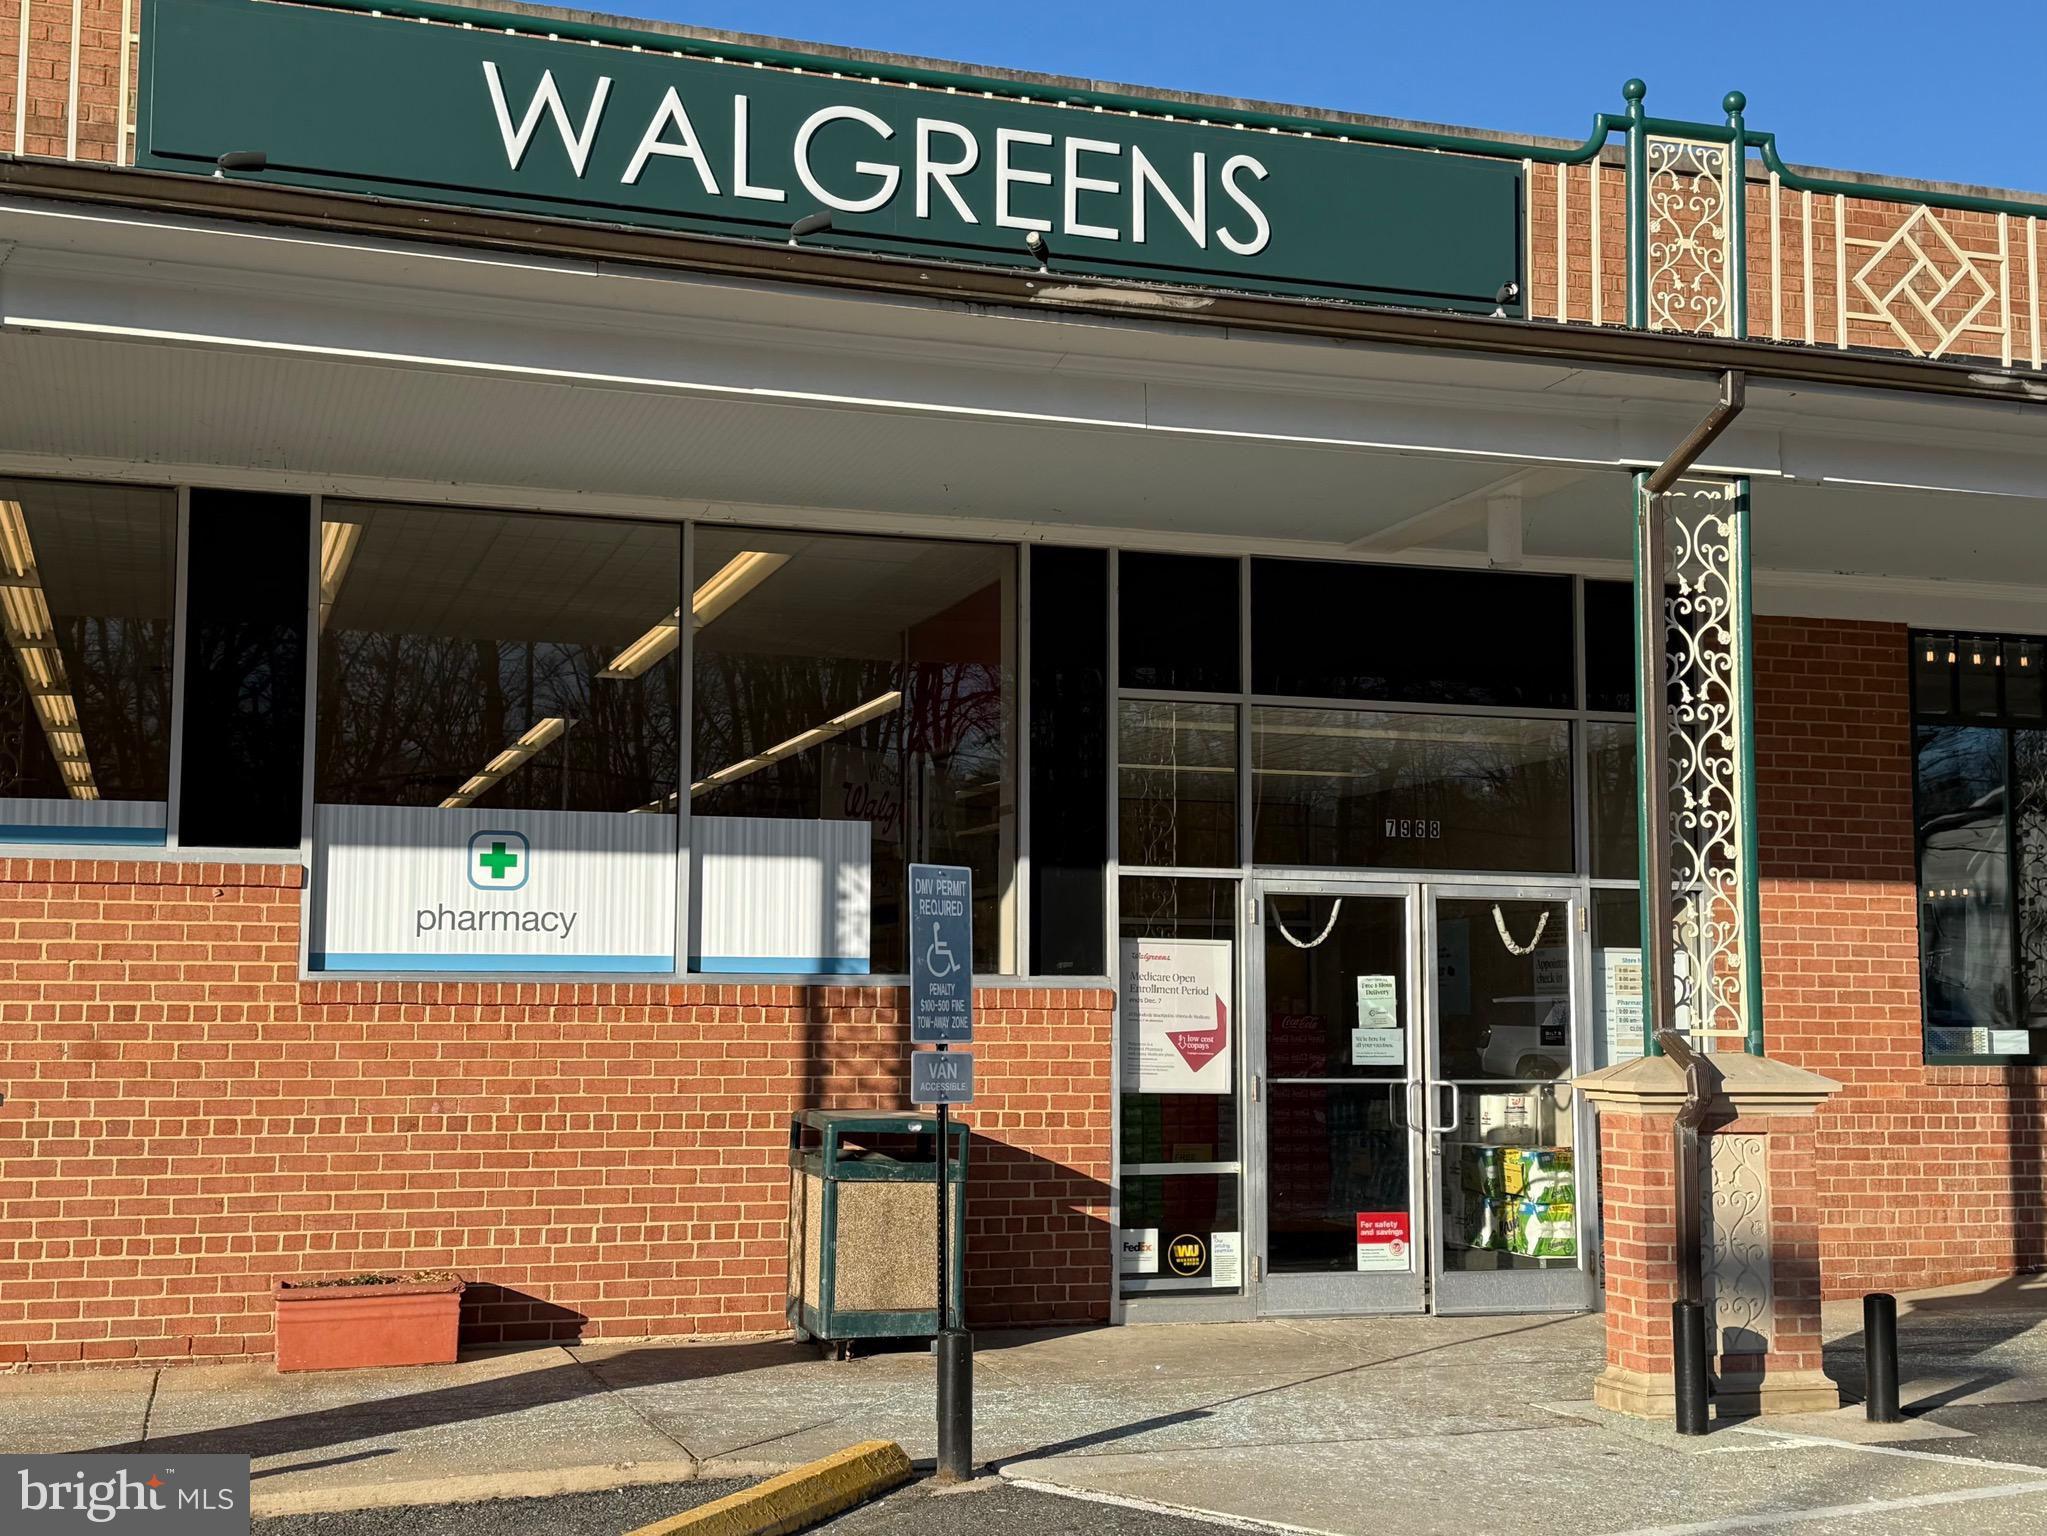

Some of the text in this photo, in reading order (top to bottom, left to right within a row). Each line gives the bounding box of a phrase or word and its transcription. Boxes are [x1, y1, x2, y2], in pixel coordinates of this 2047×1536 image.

[481, 59, 1273, 257] WALGREENS
[1386, 819, 1440, 838] 7968
[915, 878, 967, 897] DMV PERMIT
[920, 898, 963, 917] REQUIRED
[416, 903, 578, 939] pharmacy
[1131, 952, 1171, 962] Walgreens
[1129, 971, 1196, 984] Medicare Open
[929, 983, 956, 996] PENALTY
[1129, 984, 1209, 996] Enrollment Period
[920, 998, 966, 1012] $100-500 FINE
[917, 1015, 969, 1029] TOW-AWAY ZONE
[1187, 1034, 1199, 1042] low
[928, 1062, 958, 1080] VAN
[920, 1082, 966, 1092] ACCESSIBLE
[1360, 1220, 1398, 1229] For safety
[1360, 1228, 1404, 1237] and savings
[1123, 1241, 1153, 1252] FedEx
